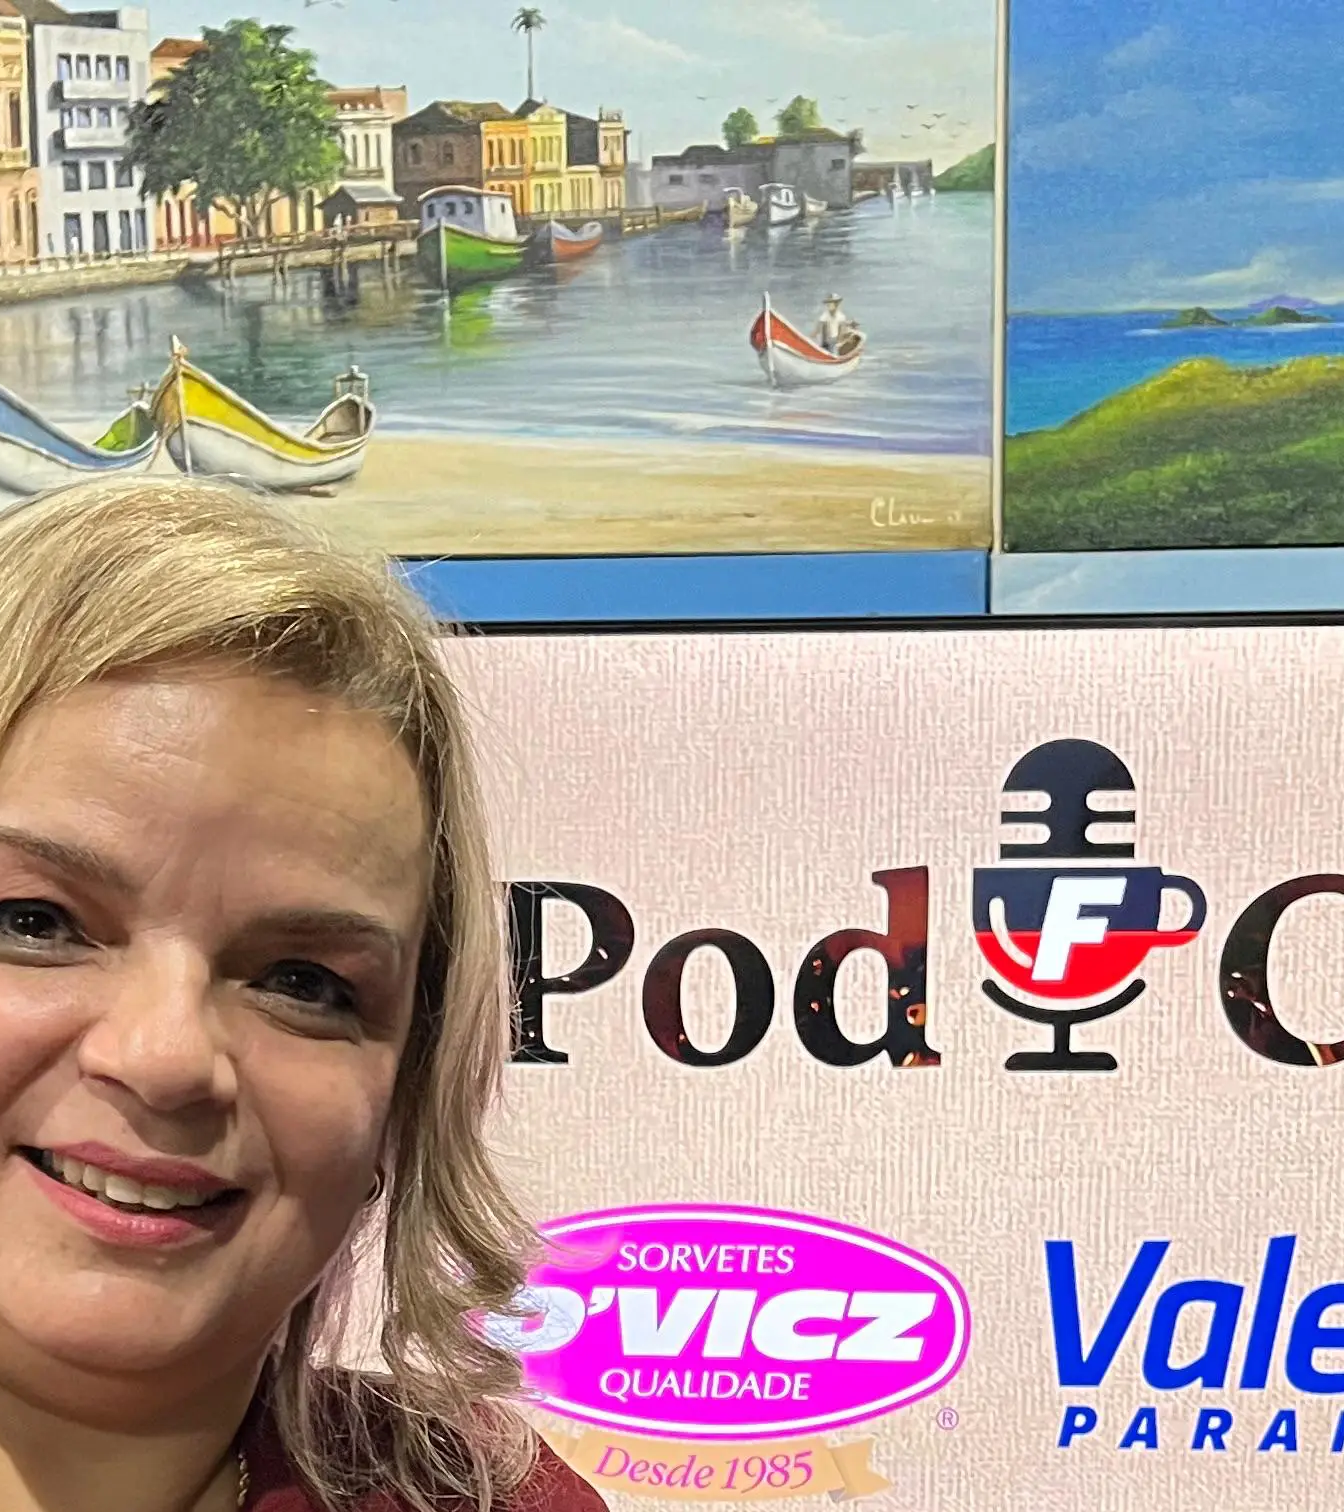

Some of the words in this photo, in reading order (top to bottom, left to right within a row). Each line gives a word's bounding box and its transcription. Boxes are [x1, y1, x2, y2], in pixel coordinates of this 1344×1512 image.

[506, 865, 942, 1068] Pod
[1031, 876, 1128, 982] F
[617, 1243, 795, 1273] SORVETES
[600, 1369, 812, 1401] QUALIDADE
[592, 1446, 715, 1487] Desde
[721, 1450, 814, 1493] 1985
